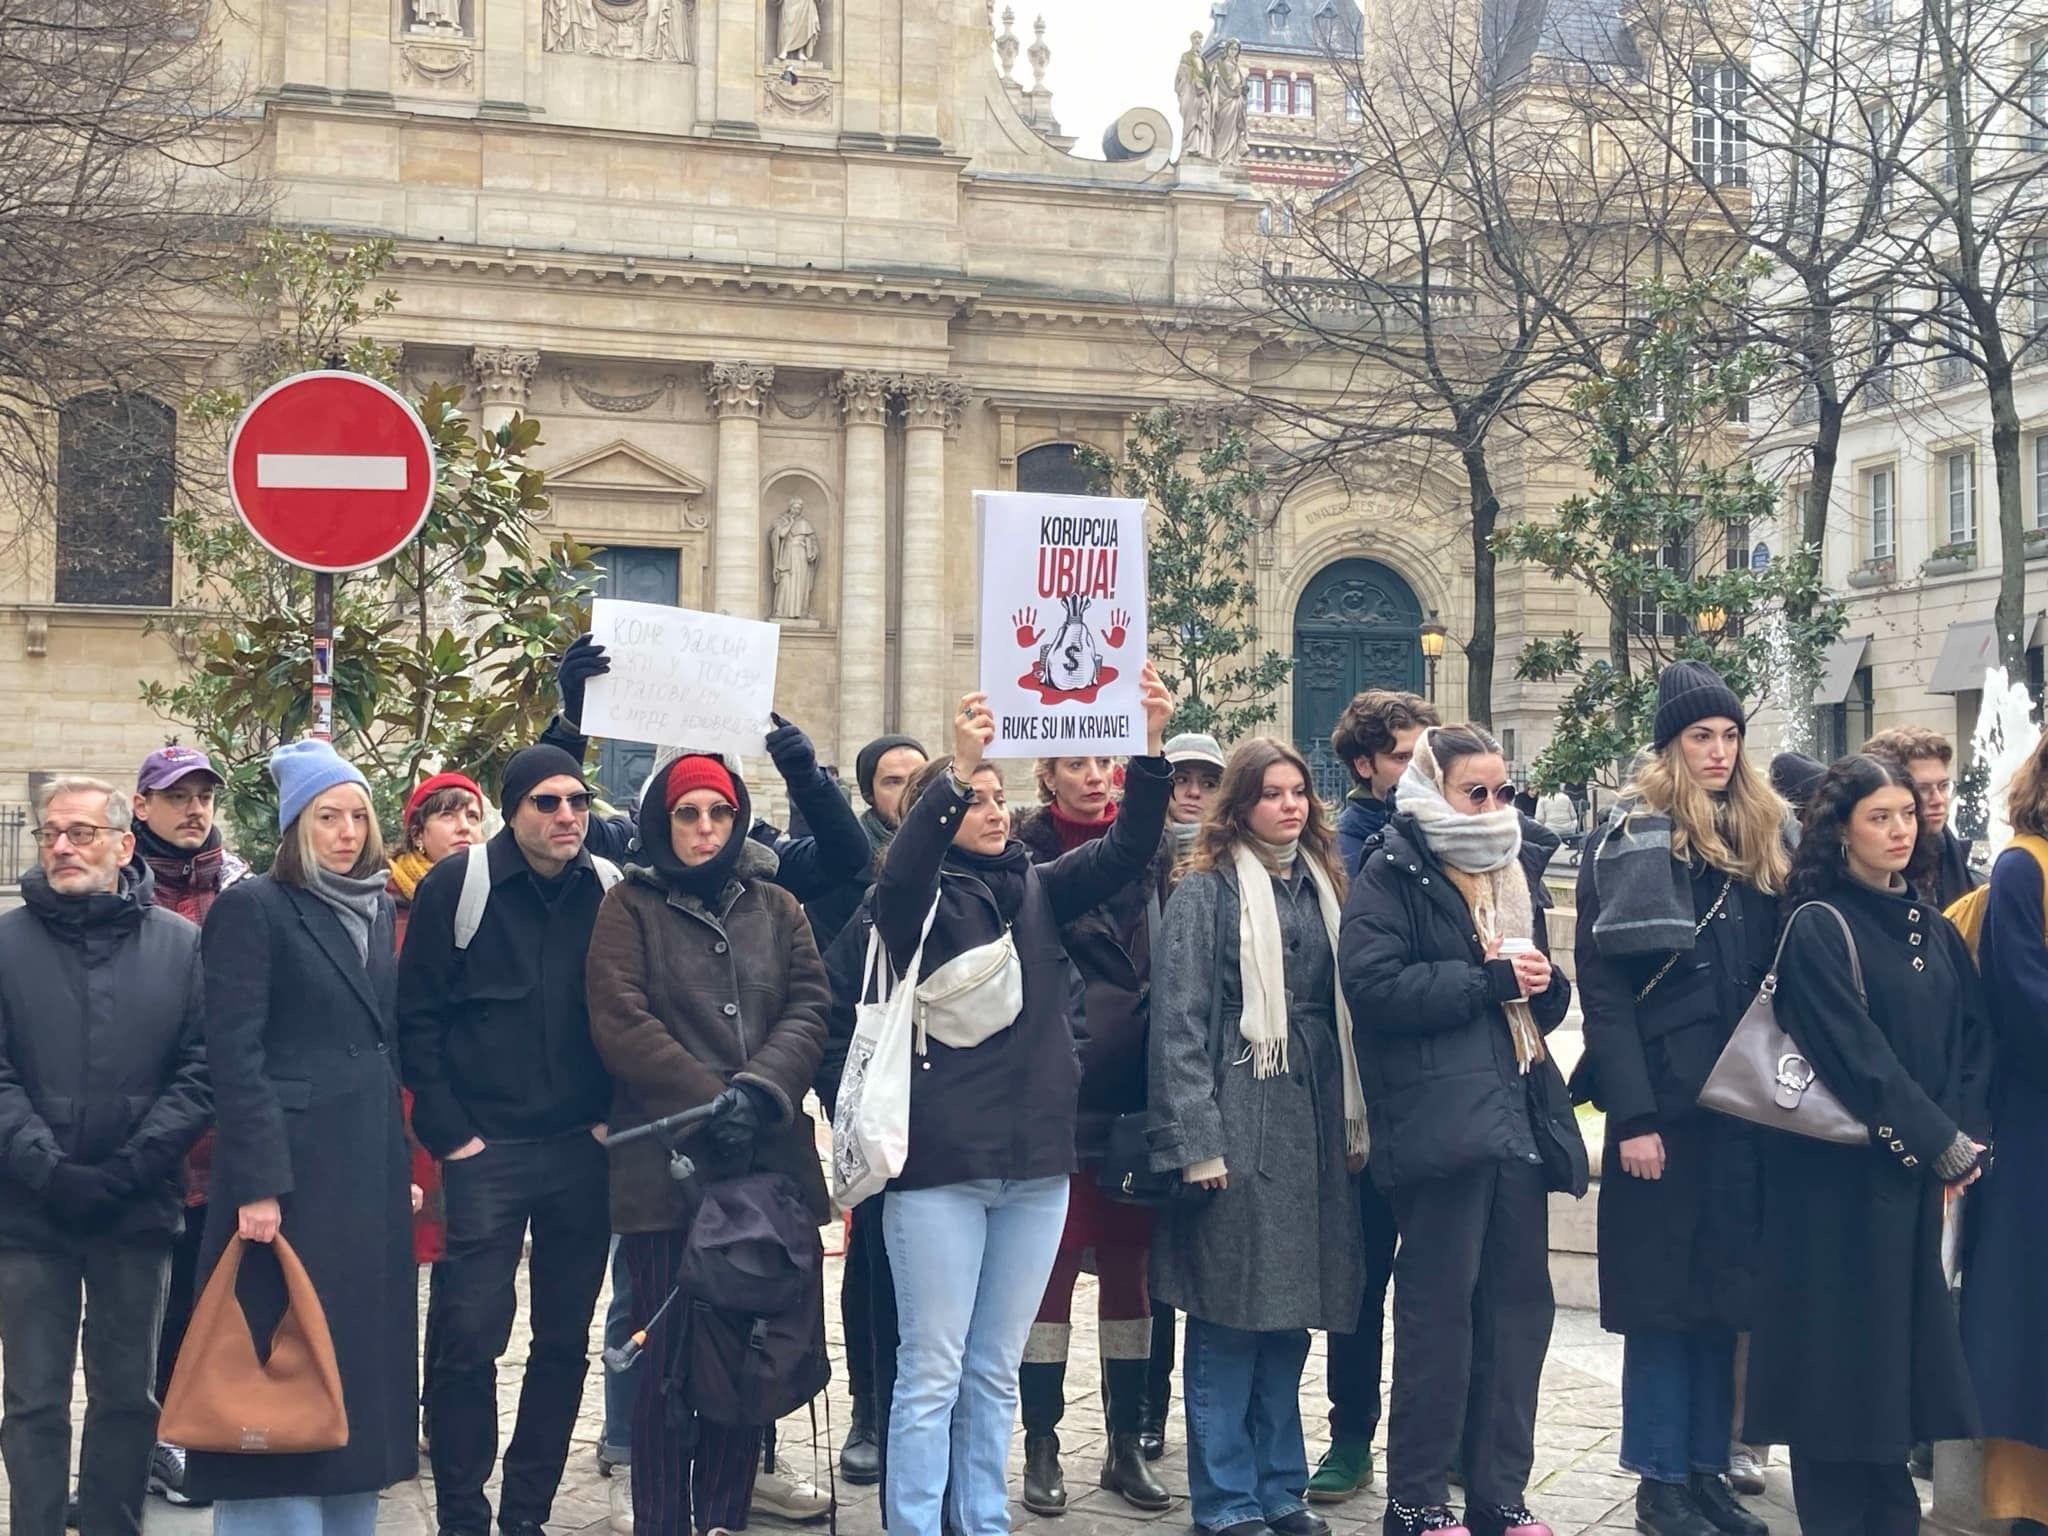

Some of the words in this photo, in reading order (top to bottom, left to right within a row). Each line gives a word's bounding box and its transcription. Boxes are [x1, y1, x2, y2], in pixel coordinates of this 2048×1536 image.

[1040, 516, 1119, 547] KORUPCIJA
[1037, 547, 1118, 600] UBIJA!
[1063, 645, 1081, 675] $
[1002, 716, 1038, 740] RUKE
[1041, 716, 1058, 740] SU
[1060, 715, 1076, 740] IM
[1079, 714, 1130, 740] KRVAVE!
